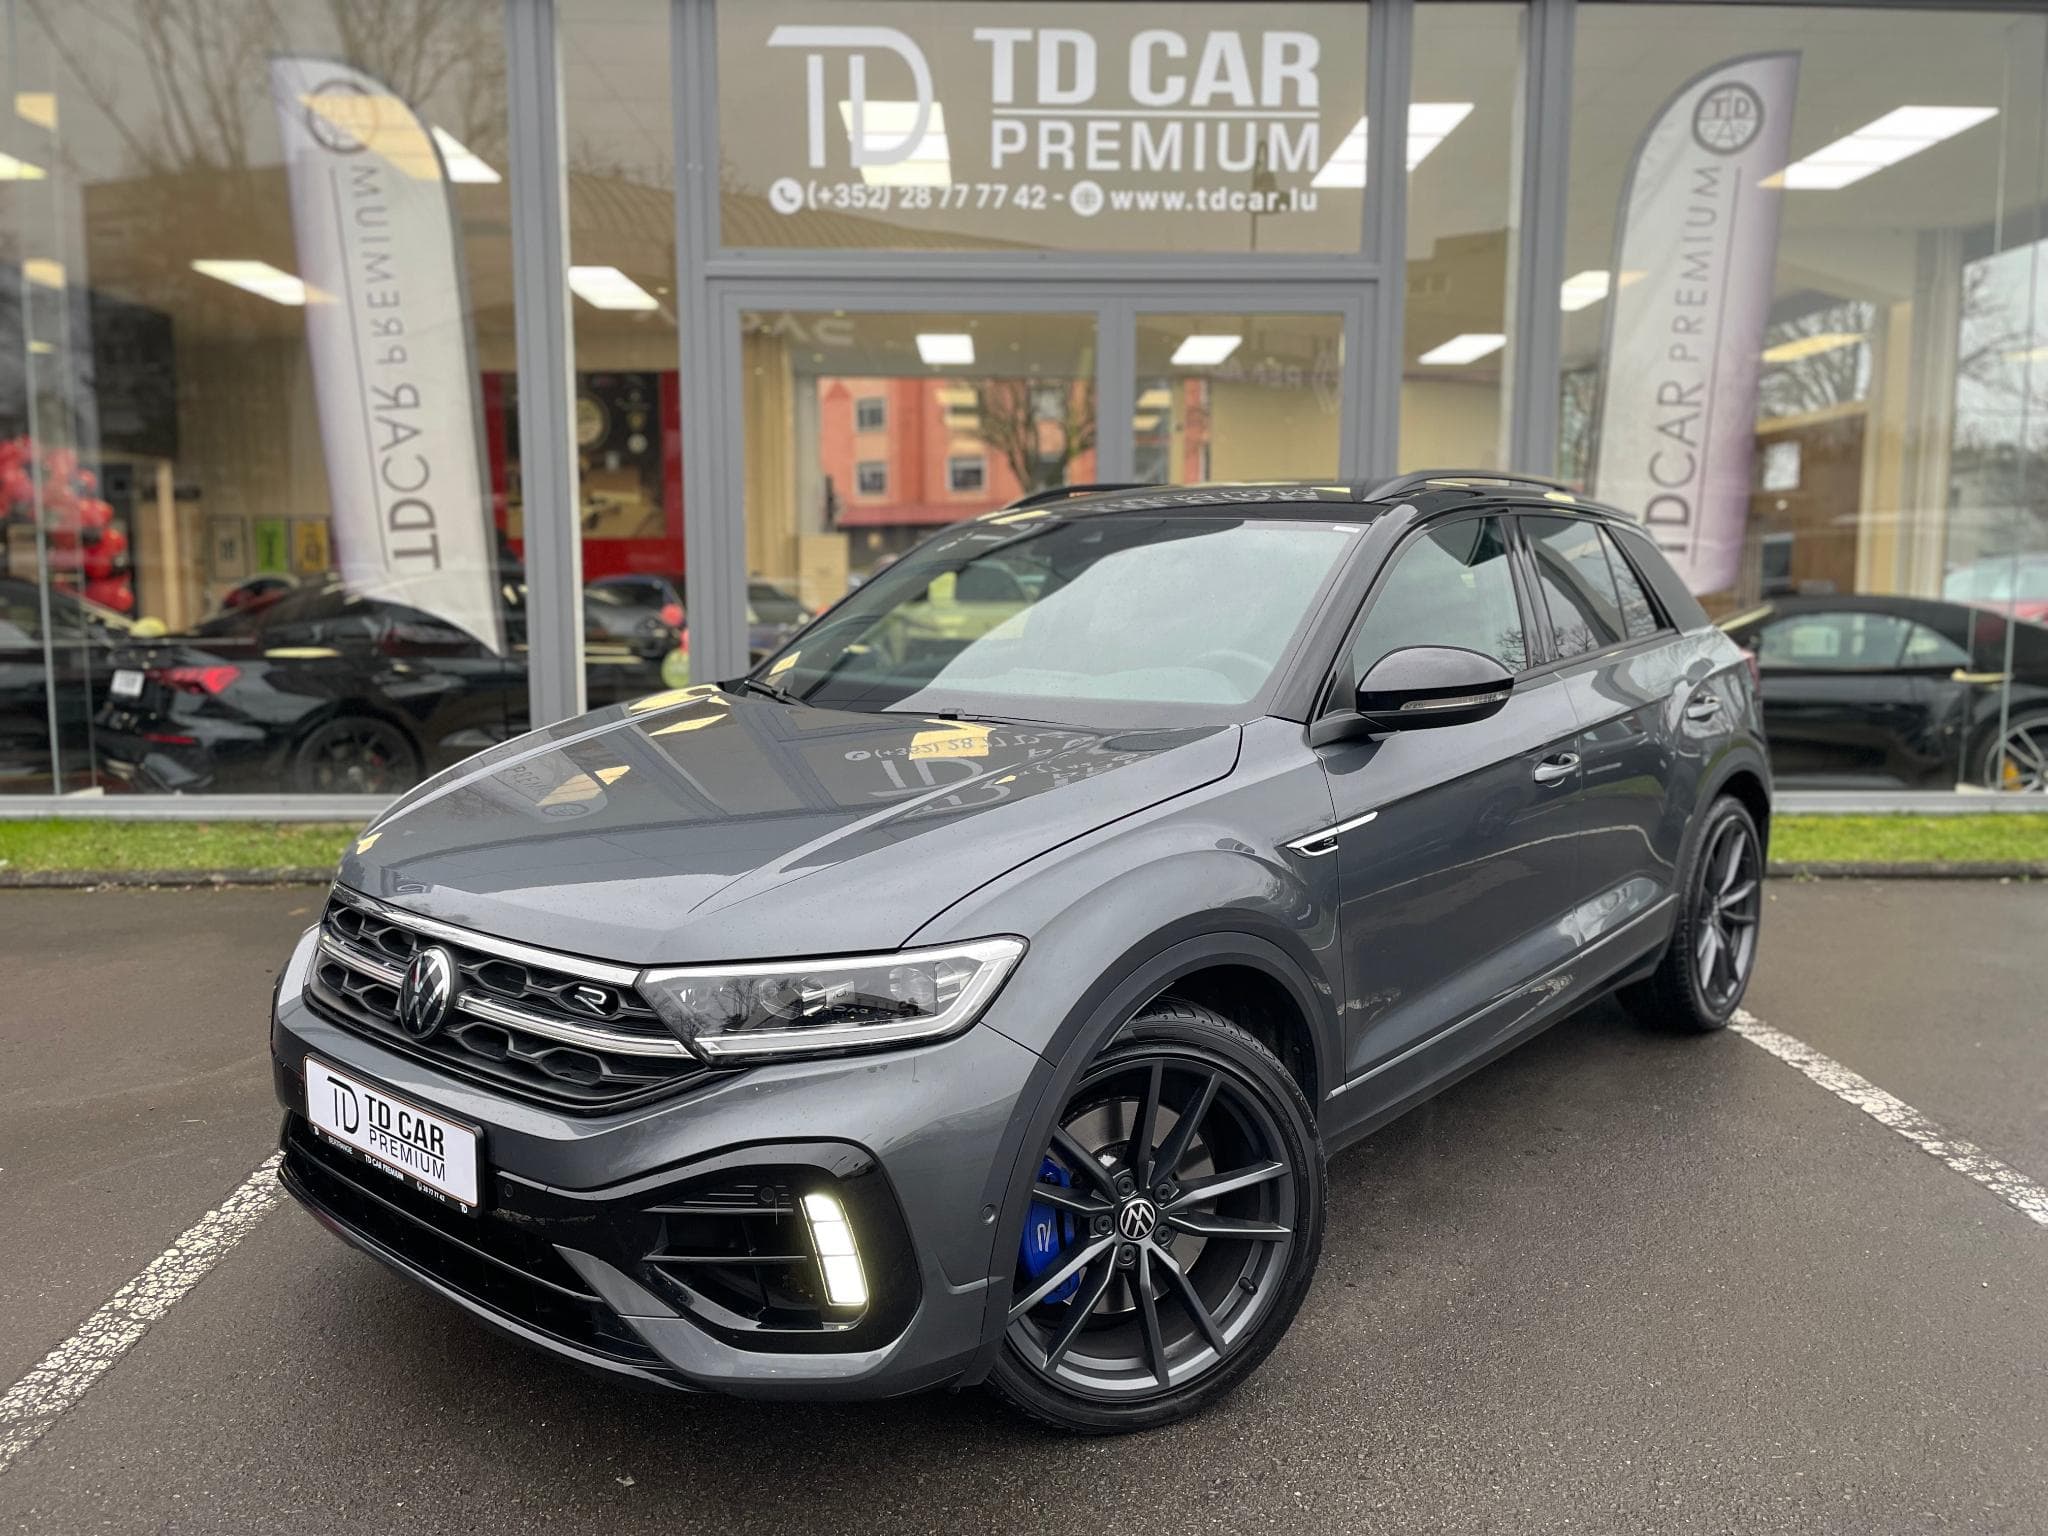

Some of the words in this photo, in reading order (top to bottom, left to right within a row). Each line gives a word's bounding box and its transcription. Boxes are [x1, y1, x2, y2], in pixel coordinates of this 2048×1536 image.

[973, 27, 1097, 104] TD
[1129, 29, 1320, 106] CAR
[991, 119, 1319, 171] PREMIUM
[807, 180, 892, 211] (+352)
[899, 184, 932, 209] 28
[940, 184, 969, 209] 77
[975, 184, 1008, 209] 77
[1013, 184, 1047, 210] 42
[1110, 186, 1318, 211] www.tdcar.lu
[1668, 166, 1721, 363] PREMIUM
[365, 1094, 391, 1131] TD
[398, 1110, 444, 1157] CAR
[369, 1128, 446, 1182] PREMIUM
